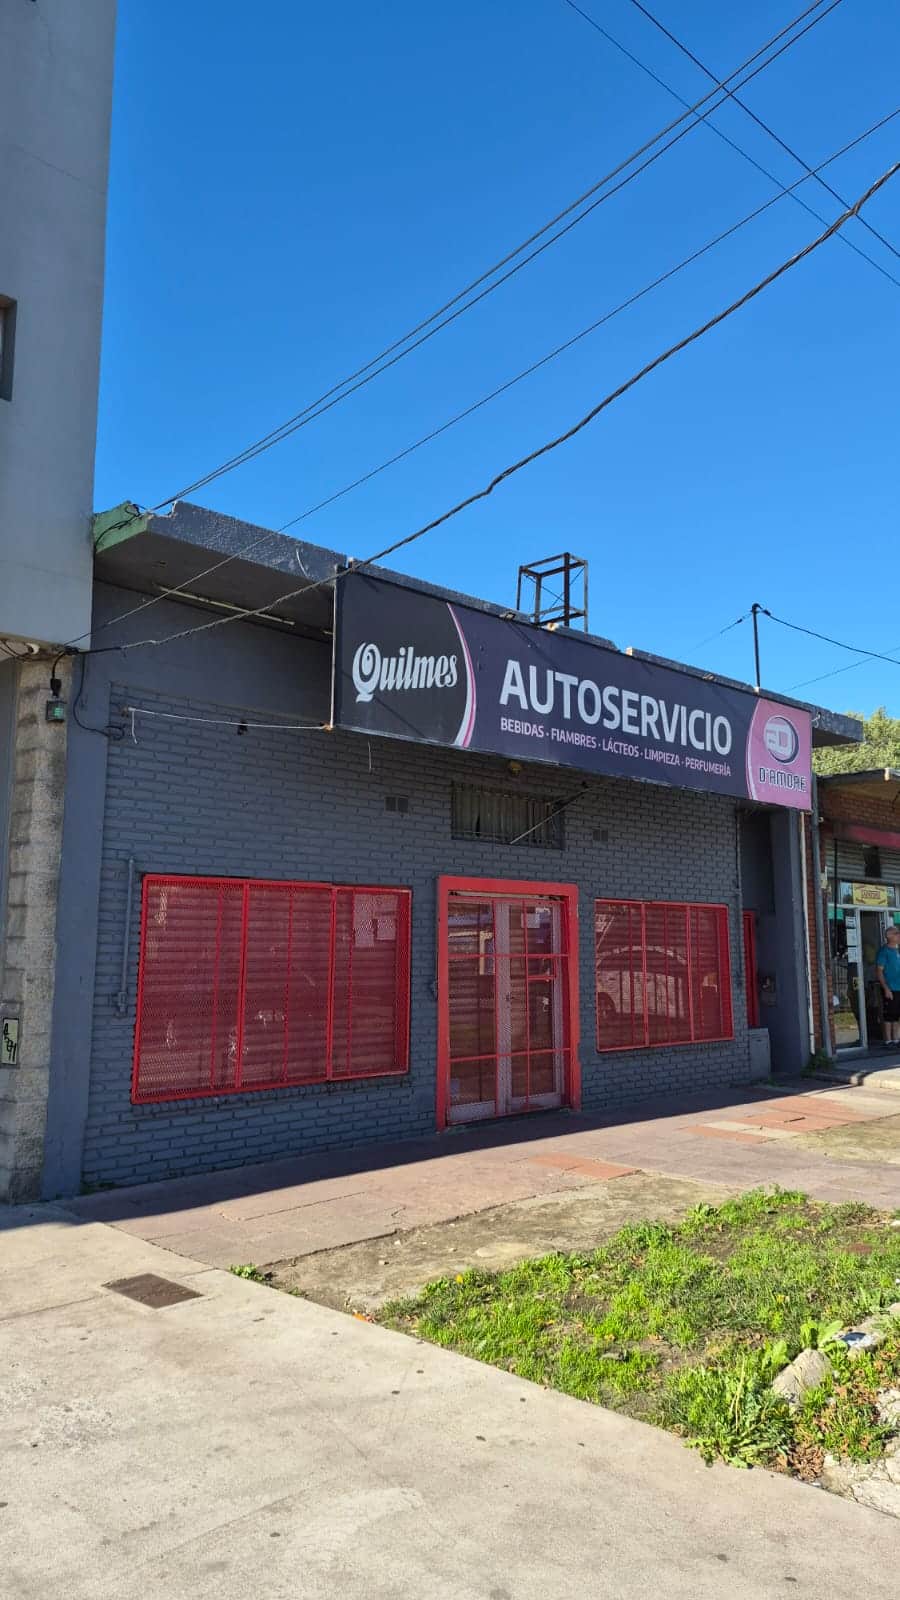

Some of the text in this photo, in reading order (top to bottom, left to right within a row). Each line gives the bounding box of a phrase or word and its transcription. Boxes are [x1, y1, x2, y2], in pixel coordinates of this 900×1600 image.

[352, 642, 457, 703] Quilmes
[499, 659, 733, 756] AUTOSERVICIO
[500, 716, 733, 777] BEBIDAS FIAMBRES LÁCTEOS LIMPIEZA PERFUMERÍA
